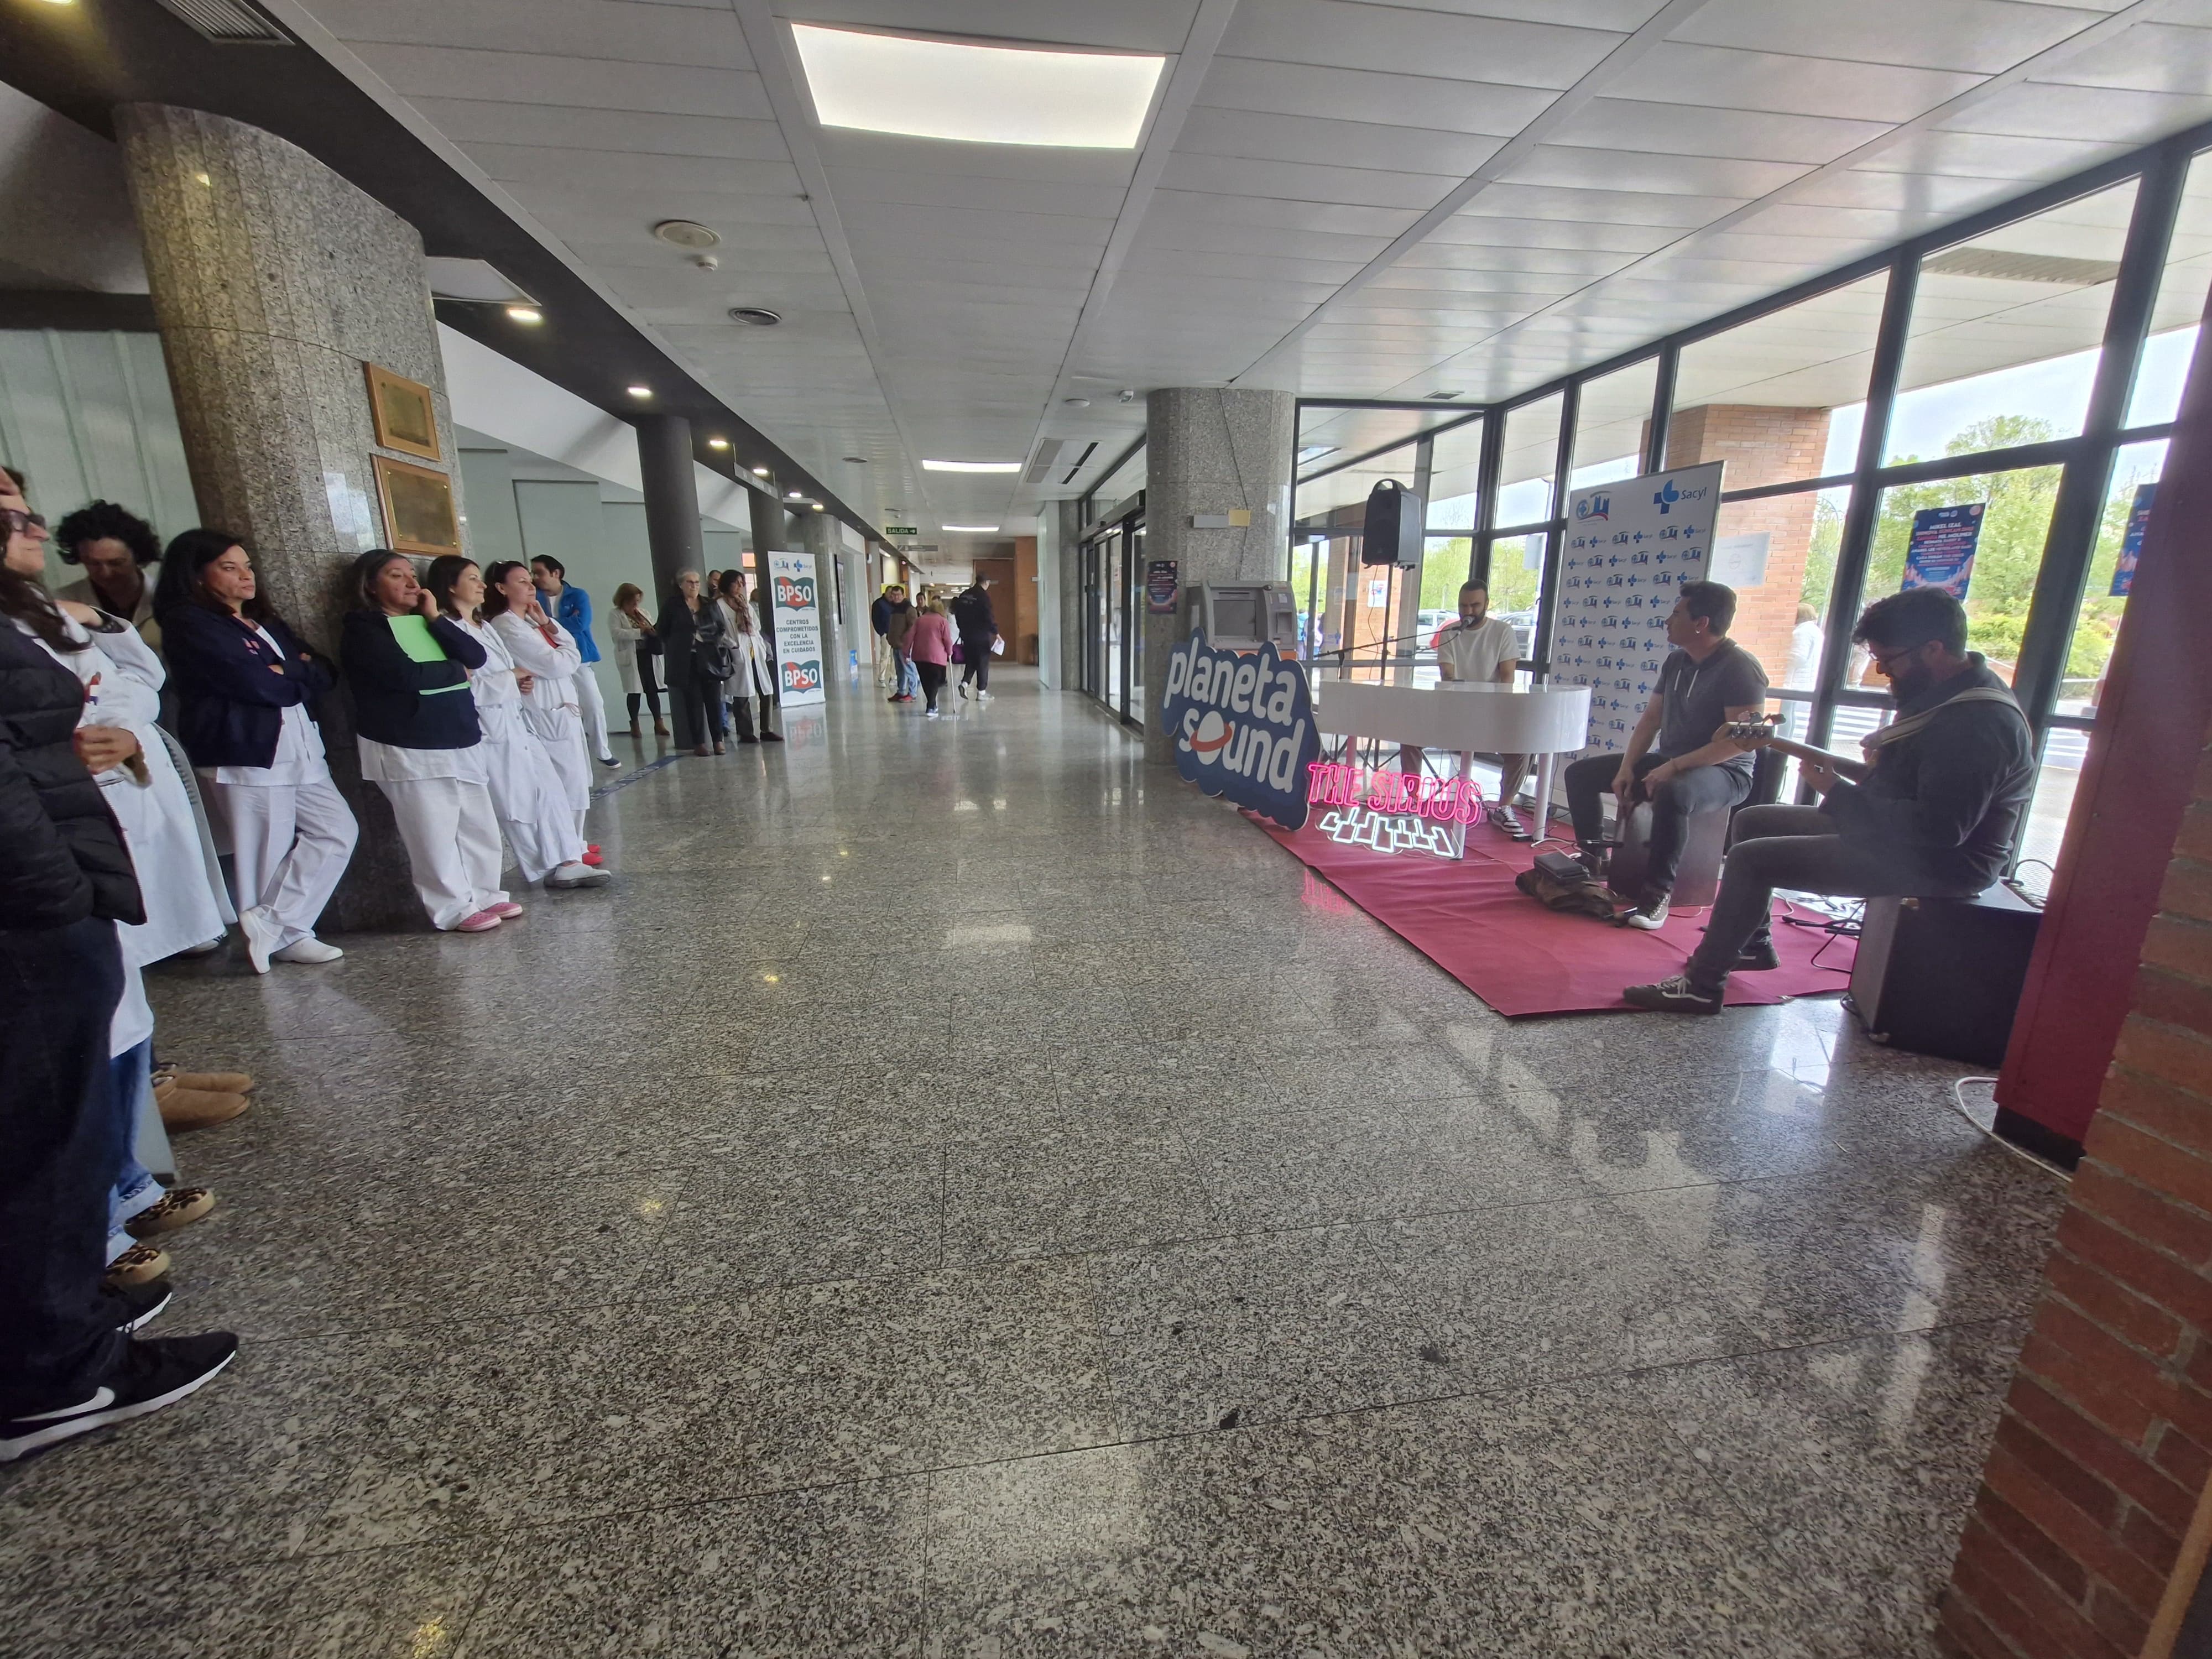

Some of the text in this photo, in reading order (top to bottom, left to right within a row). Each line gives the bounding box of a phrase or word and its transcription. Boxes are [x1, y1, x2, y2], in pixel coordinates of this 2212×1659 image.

[1681, 487, 1707, 500] Sacyl
[777, 585, 812, 602] BPSO
[785, 668, 818, 687] BPSO
[1164, 637, 1297, 727] planeta
[1178, 708, 1305, 794] sound
[1307, 763, 1364, 806] THE
